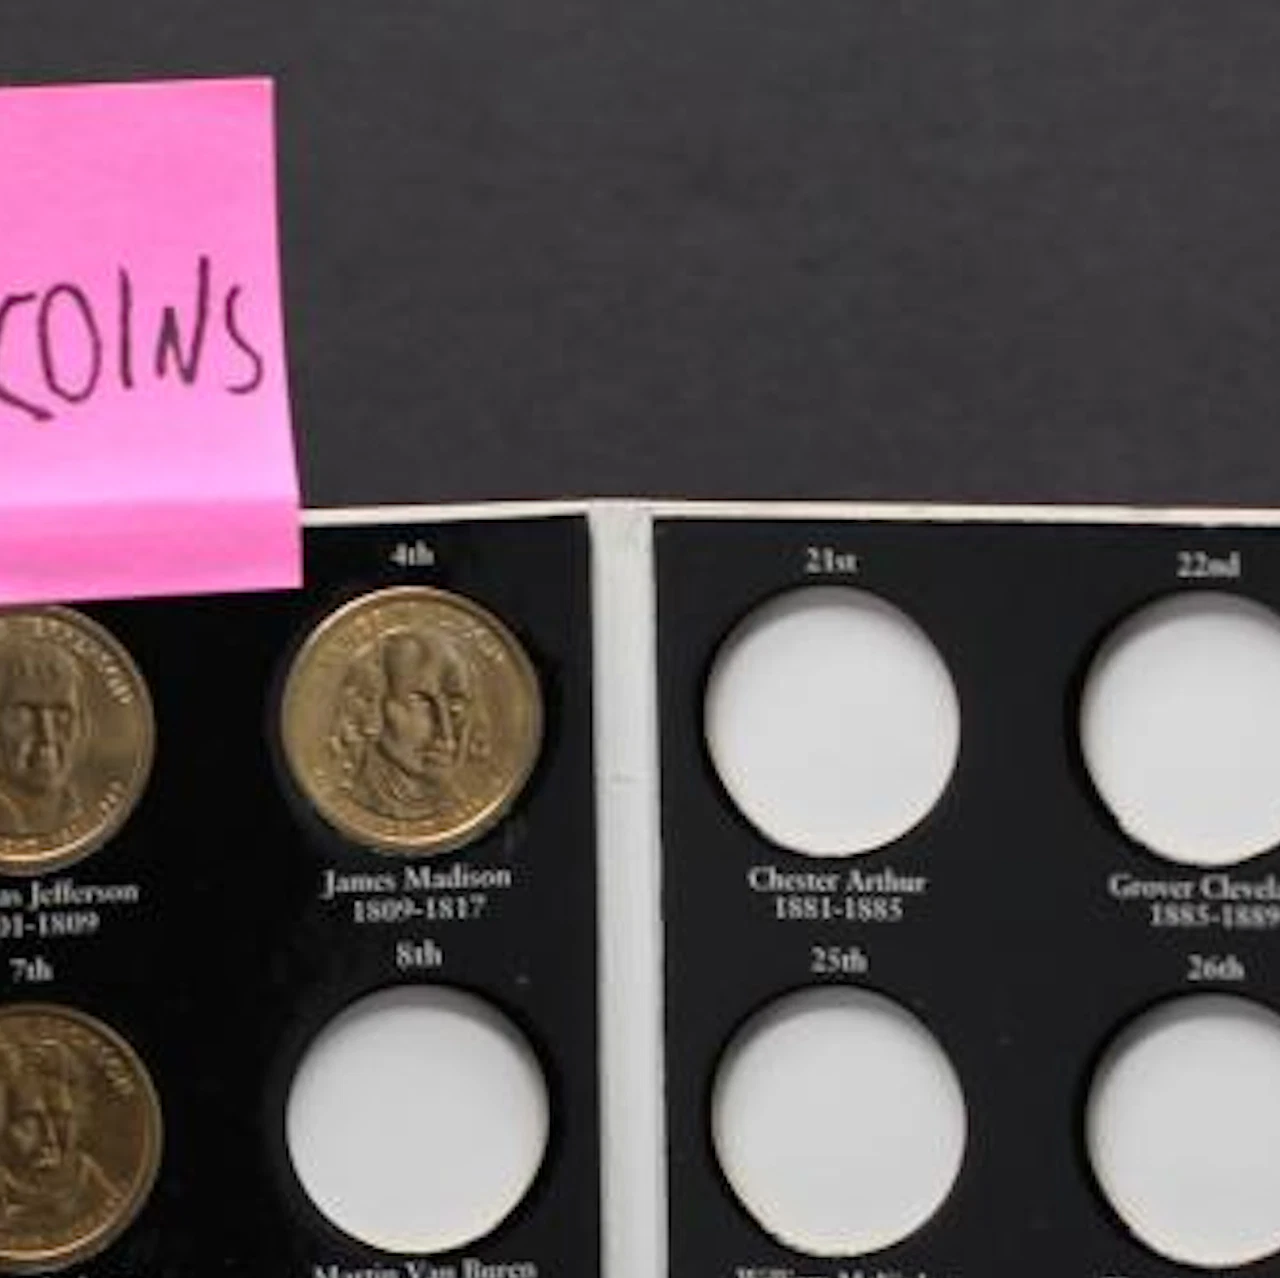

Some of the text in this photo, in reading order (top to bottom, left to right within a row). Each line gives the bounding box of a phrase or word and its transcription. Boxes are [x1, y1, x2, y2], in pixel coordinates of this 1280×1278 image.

[391, 541, 435, 568] 4th
[805, 547, 858, 574] 21st
[1176, 552, 1240, 578] 22nd
[323, 866, 511, 900] James Madison
[747, 866, 927, 896] Chester Arthur
[1108, 874, 1193, 900] Grover
[29, 880, 139, 911] Jefferson
[353, 896, 486, 923] 1809-1817
[775, 897, 904, 922] 1881-1885
[395, 942, 442, 970] 8th
[811, 947, 869, 973] 25th
[1187, 954, 1244, 981] 26th
[9, 958, 54, 983] 7th
